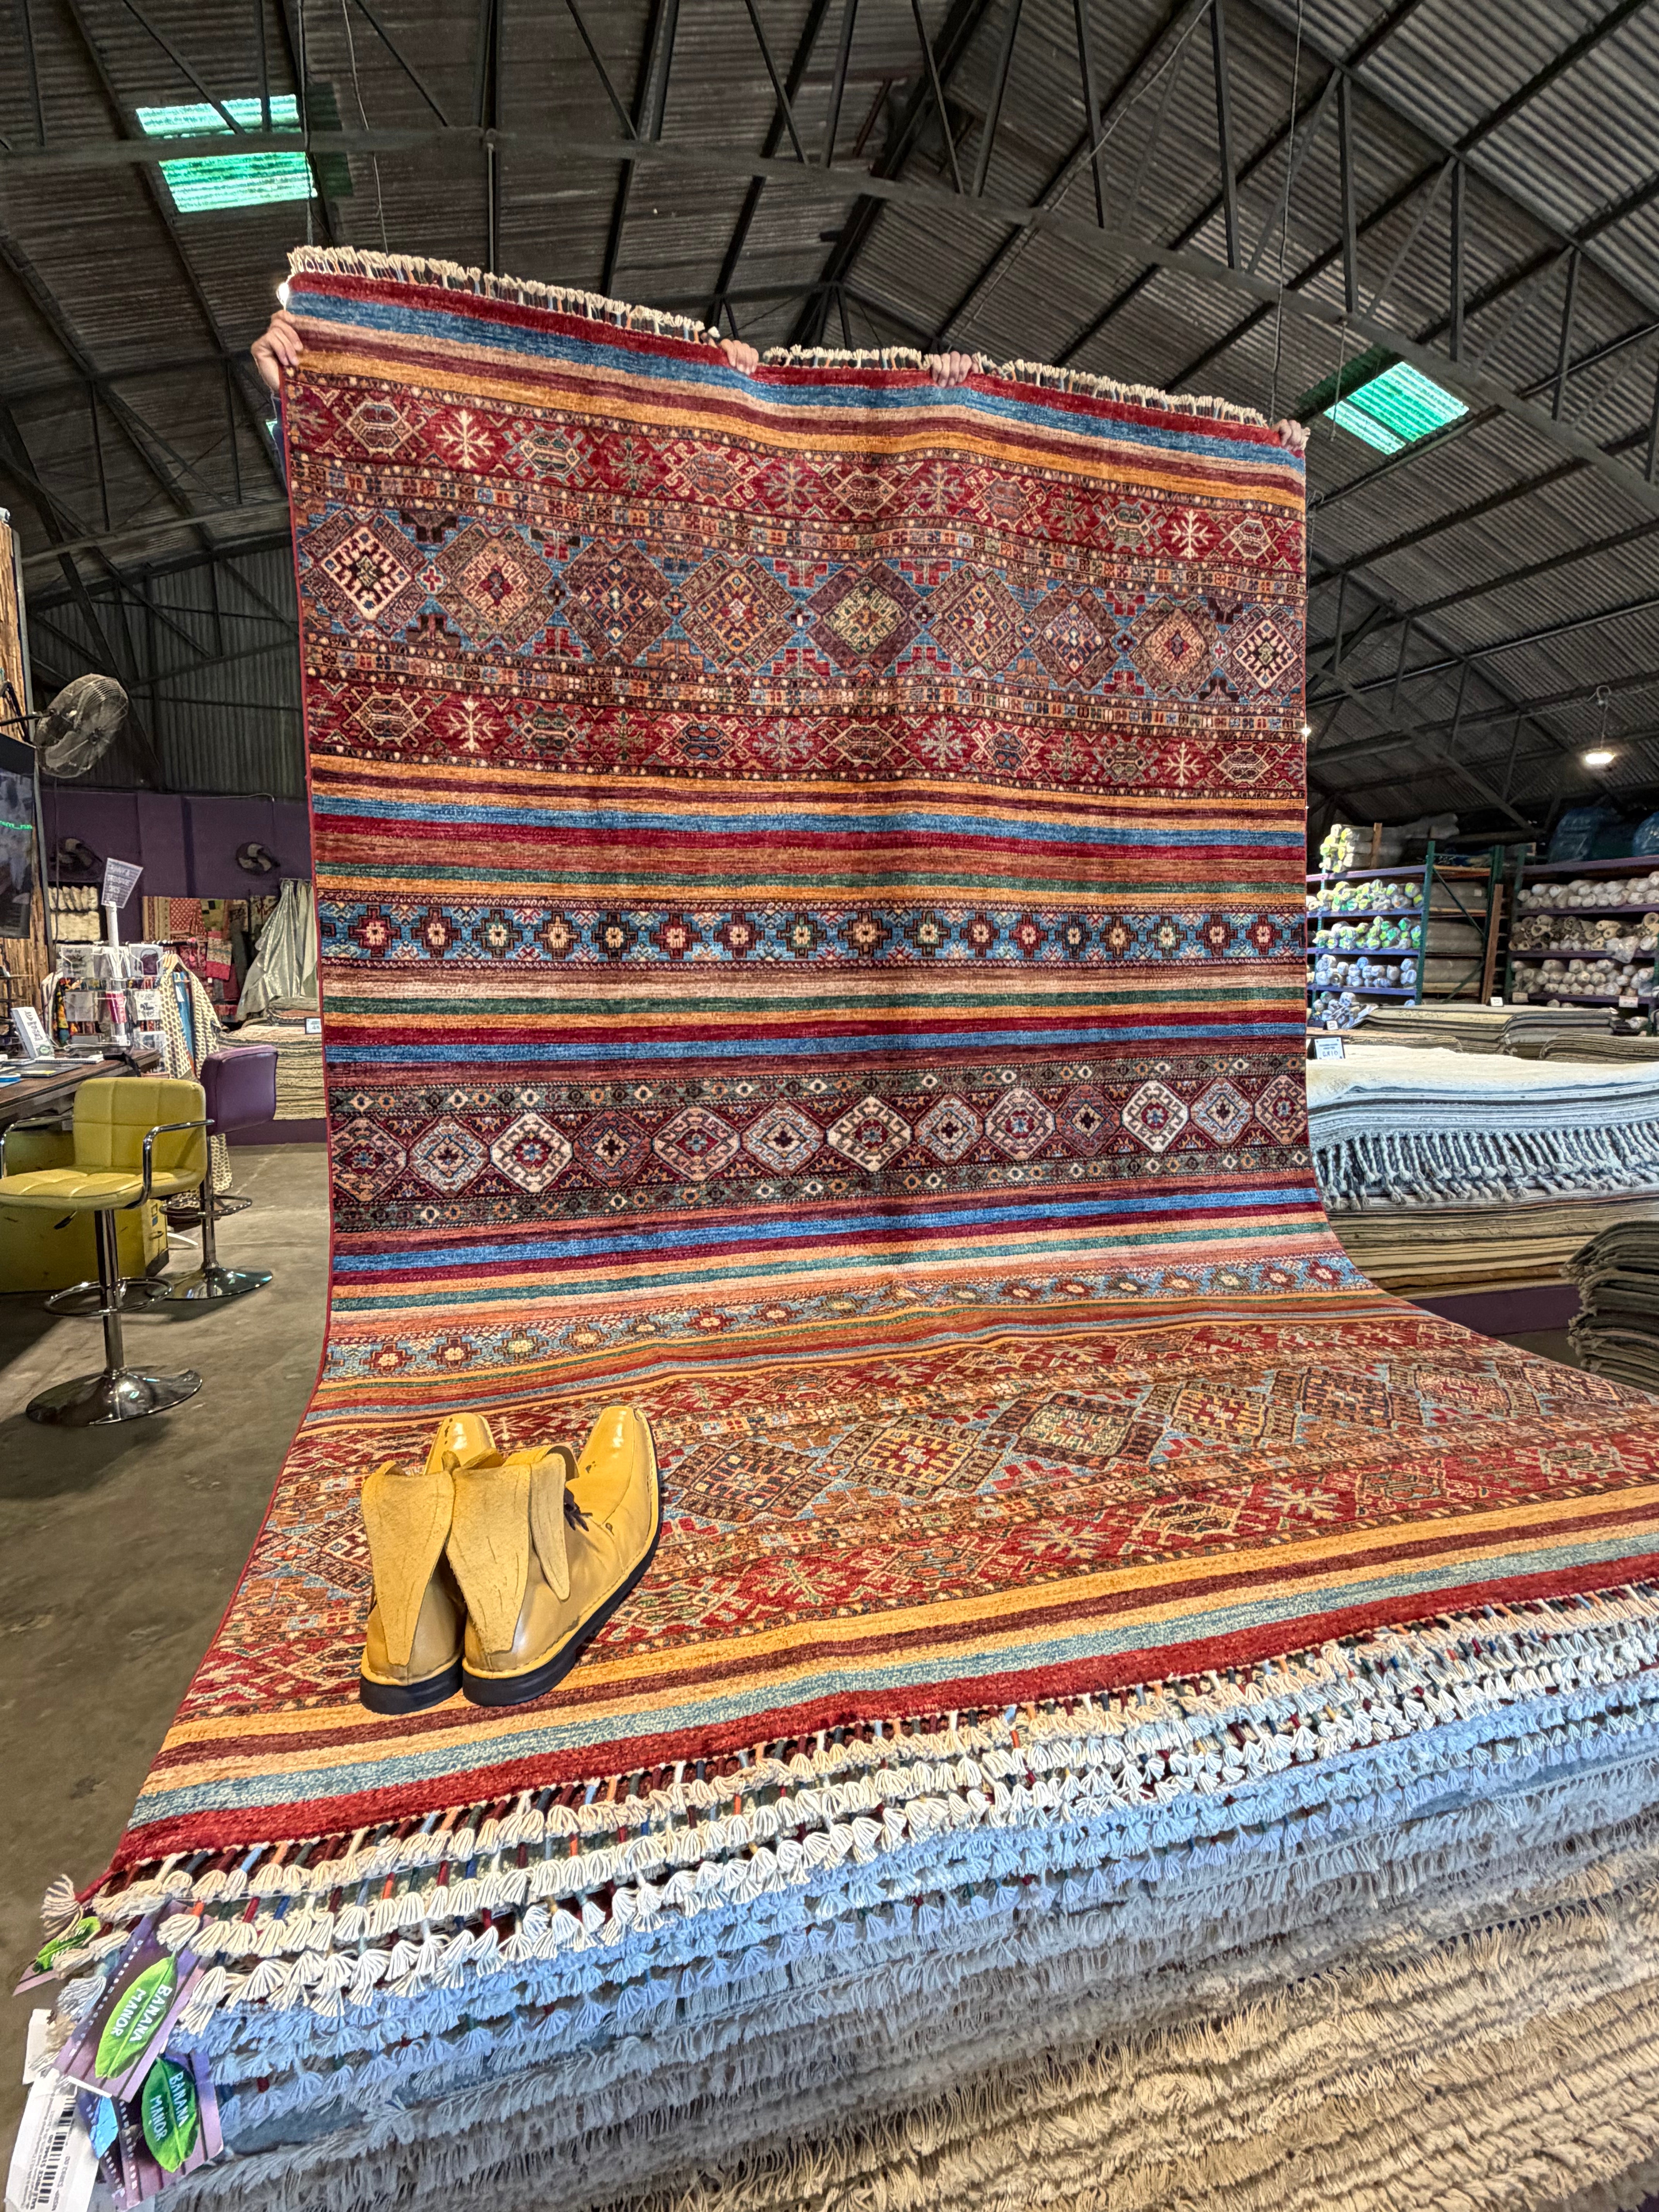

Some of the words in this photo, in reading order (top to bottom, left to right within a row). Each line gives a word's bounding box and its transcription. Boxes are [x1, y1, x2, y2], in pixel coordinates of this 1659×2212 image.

[110, 1987, 148, 2036] MANOR
[129, 1984, 173, 2042] BANANA
[149, 2095, 168, 2141] MANOR
[168, 2071, 190, 2128] BANANA
